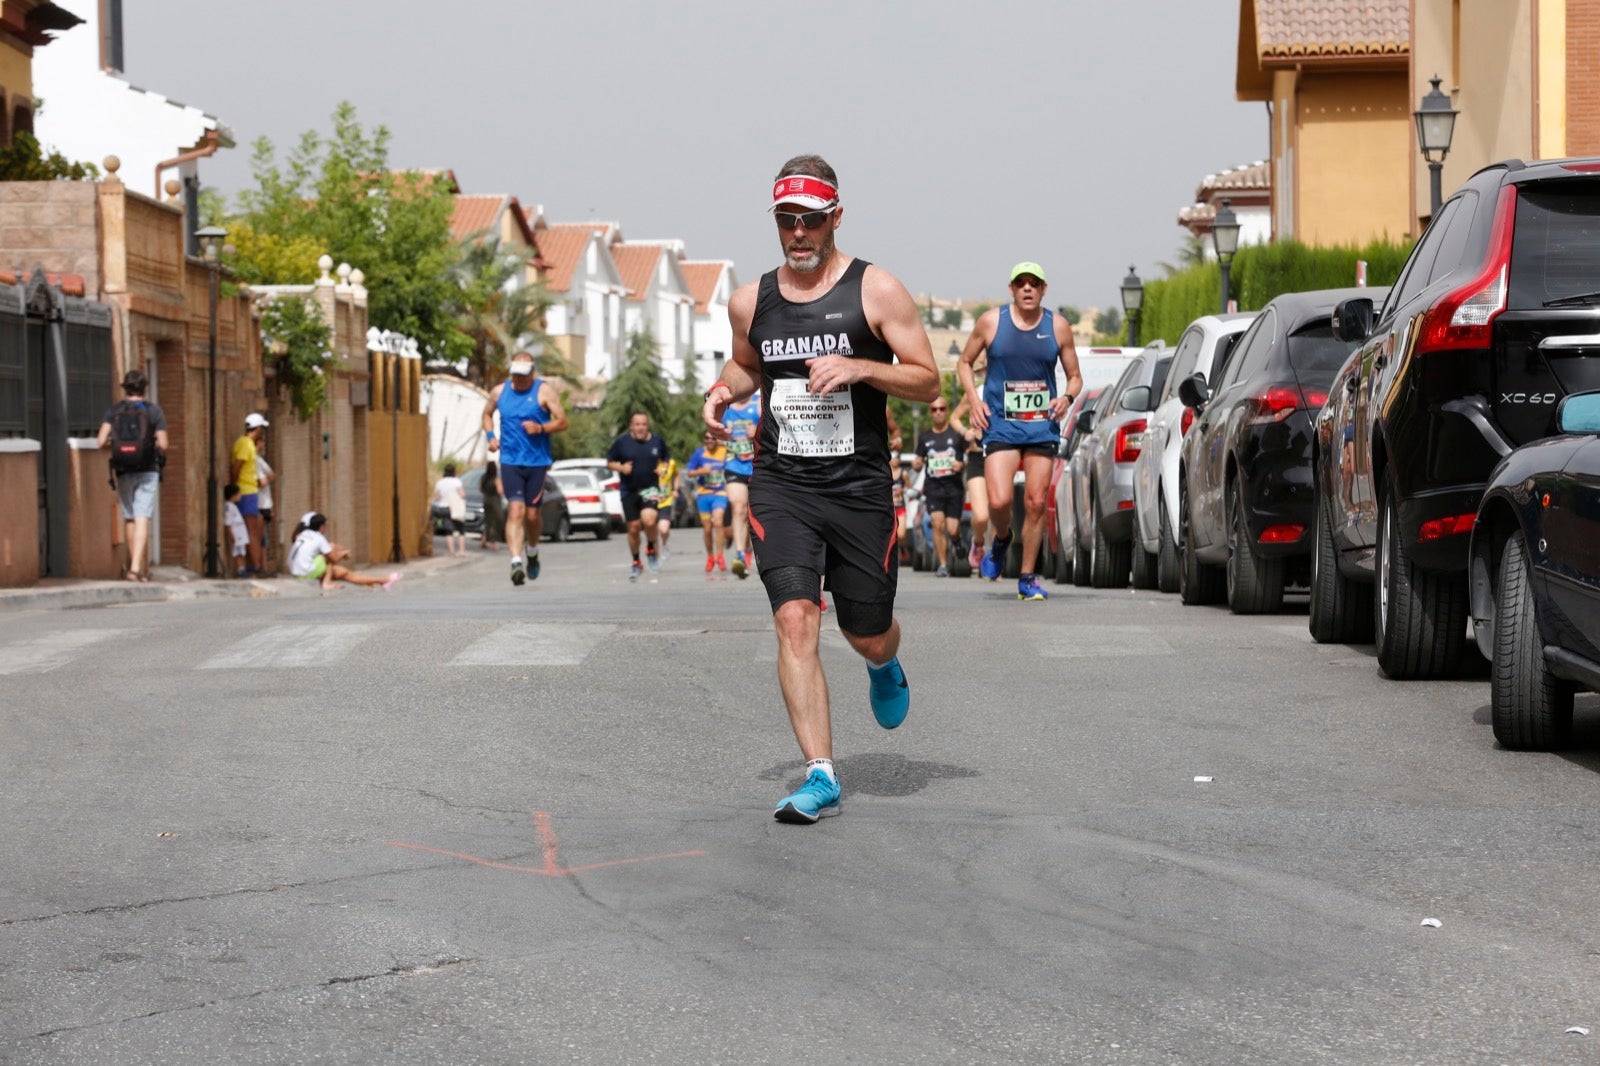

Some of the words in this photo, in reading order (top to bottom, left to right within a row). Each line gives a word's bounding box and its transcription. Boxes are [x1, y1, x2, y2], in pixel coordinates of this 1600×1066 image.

[761, 332, 851, 356] GRANADA
[815, 403, 850, 411] CONTRA
[1013, 393, 1043, 409] 170
